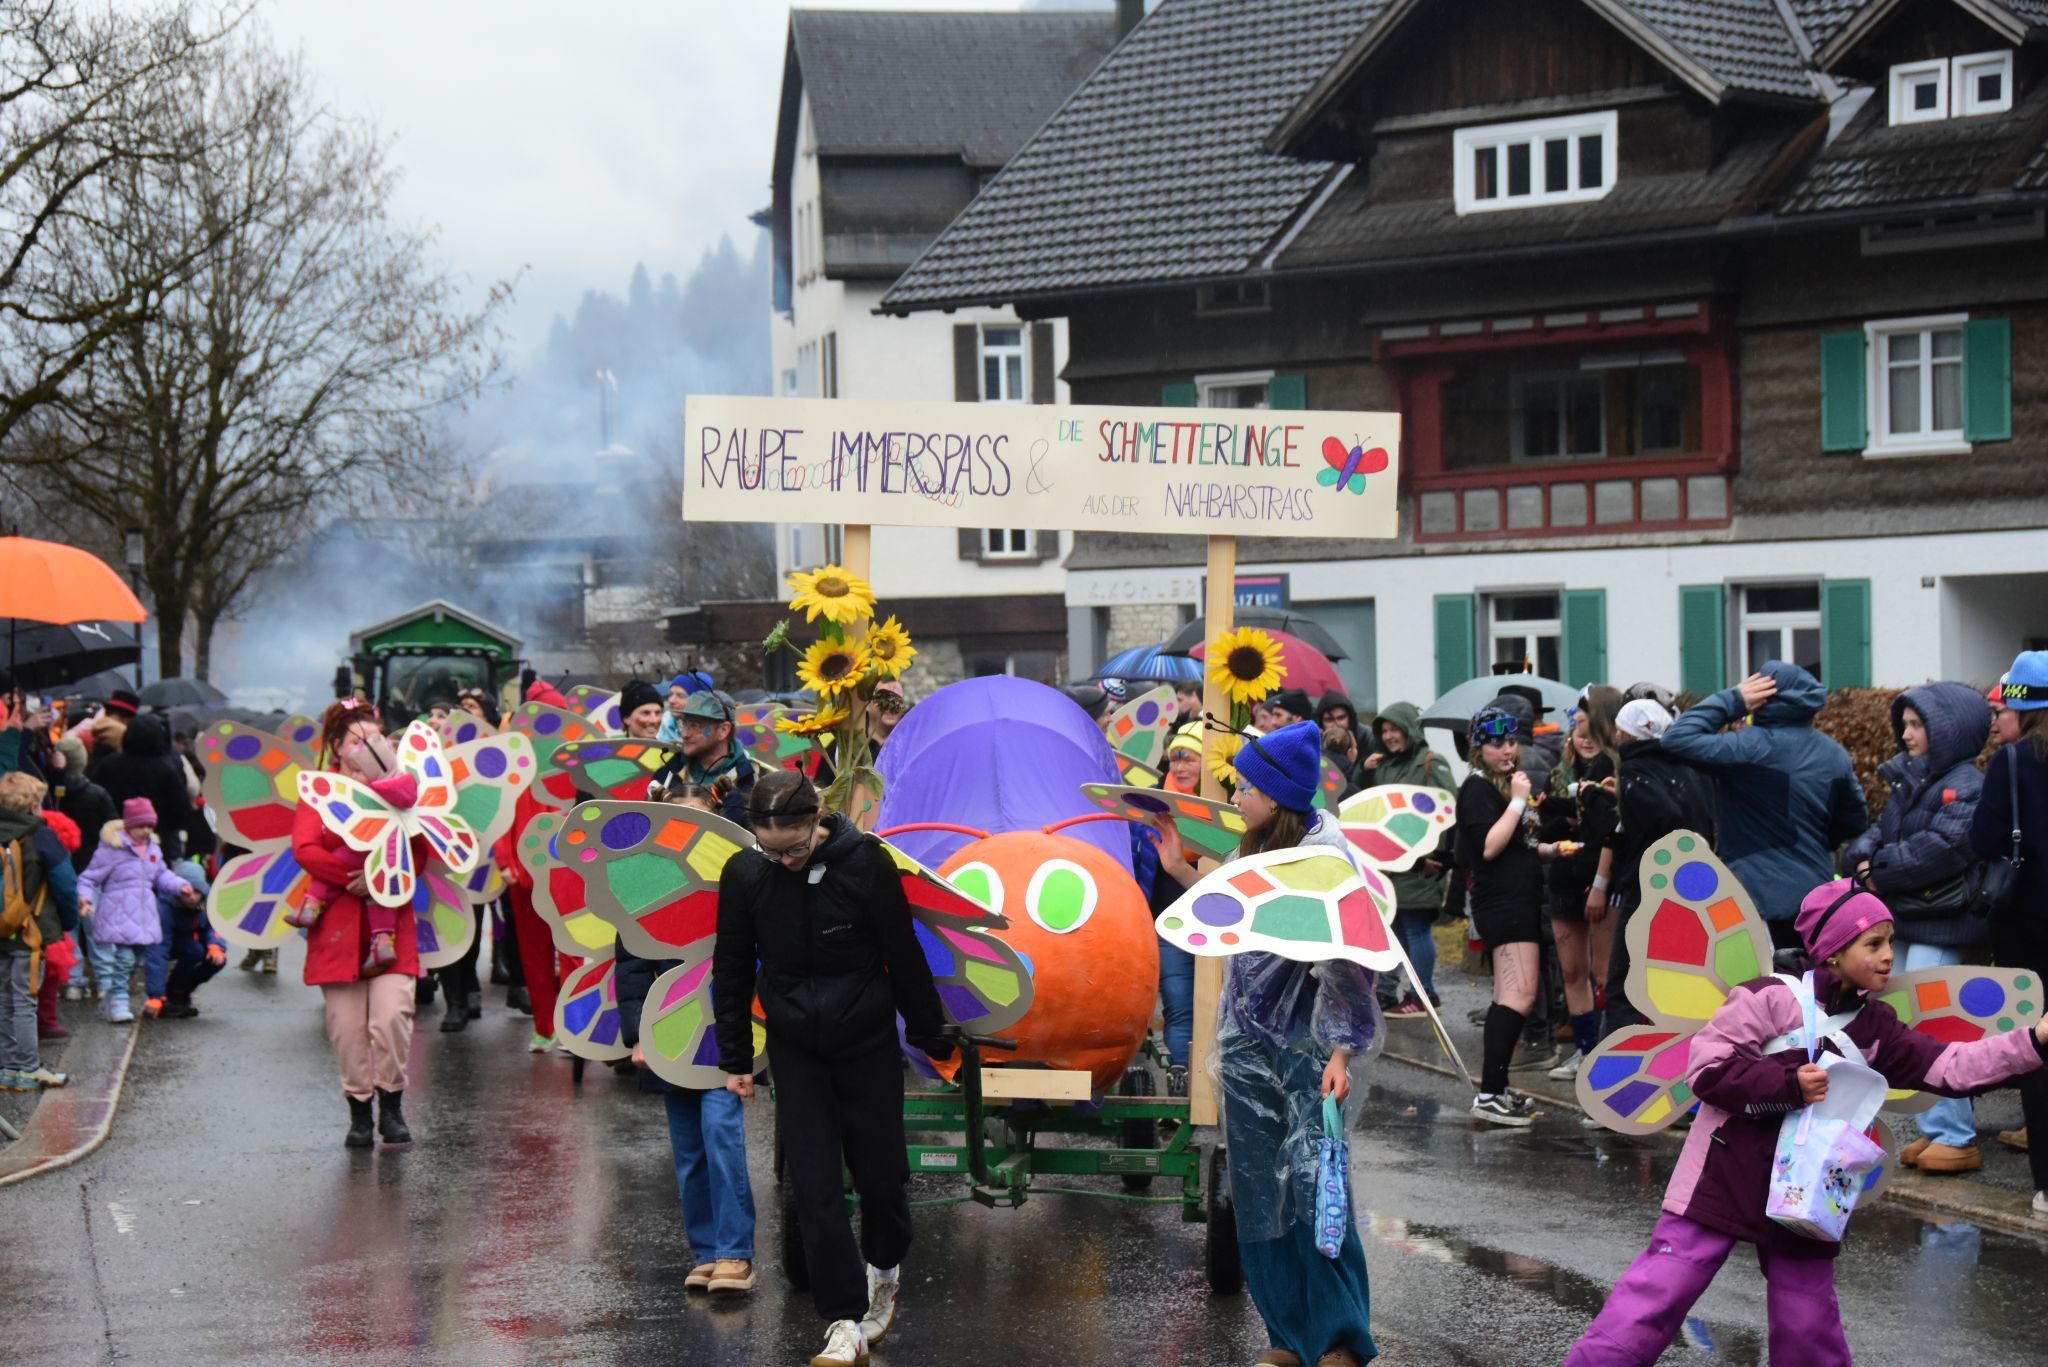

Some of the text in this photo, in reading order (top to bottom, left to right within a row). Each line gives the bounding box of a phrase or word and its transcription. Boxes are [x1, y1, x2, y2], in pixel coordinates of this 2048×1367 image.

[701, 426, 1055, 497] RAUPE IMMERSPASS &
[1058, 419, 1304, 467] DIE SCHMETTERLINGE
[1082, 482, 1315, 521] AUS DER NACHBARSTRASS
